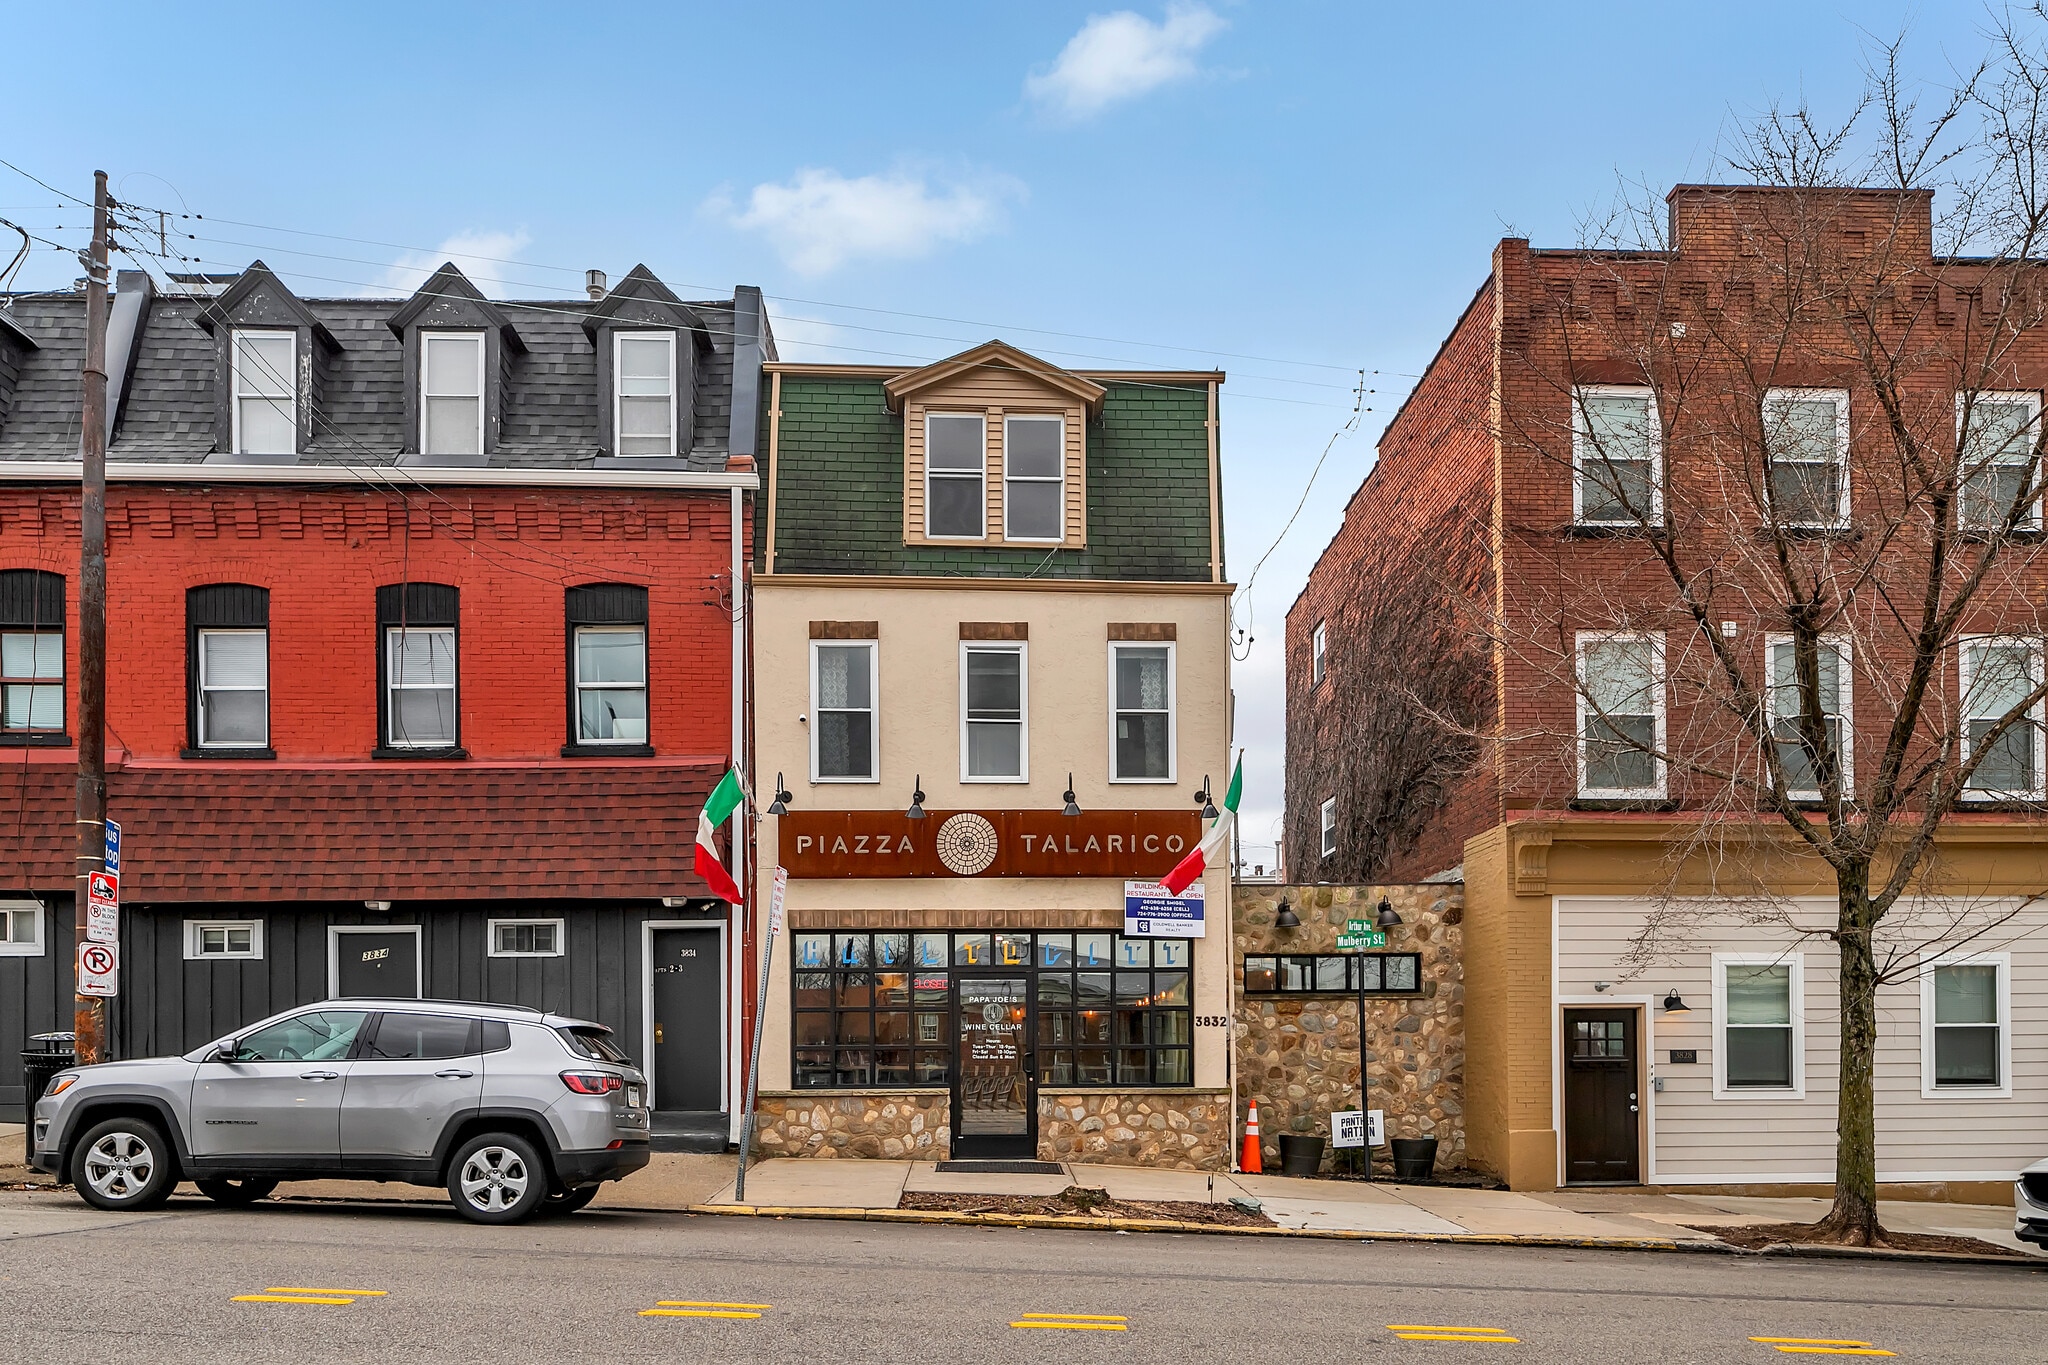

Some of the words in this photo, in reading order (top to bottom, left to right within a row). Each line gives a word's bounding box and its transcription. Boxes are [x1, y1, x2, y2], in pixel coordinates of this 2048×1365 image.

[797, 835, 914, 854] PIAZZA
[1020, 834, 1184, 853] TALARICO
[106, 845, 117, 865] top
[1348, 921, 1362, 930] Arthur
[1337, 935, 1371, 947] Mulberry
[1373, 934, 1384, 944] St.
[363, 949, 388, 960] 3834
[681, 948, 696, 957] 3834
[913, 979, 948, 990] CLOSED
[1195, 1016, 1227, 1027] 3832
[1676, 1051, 1693, 1059] 3828
[1341, 1116, 1374, 1127] PANTHR
[1342, 1127, 1375, 1138] NATIN
